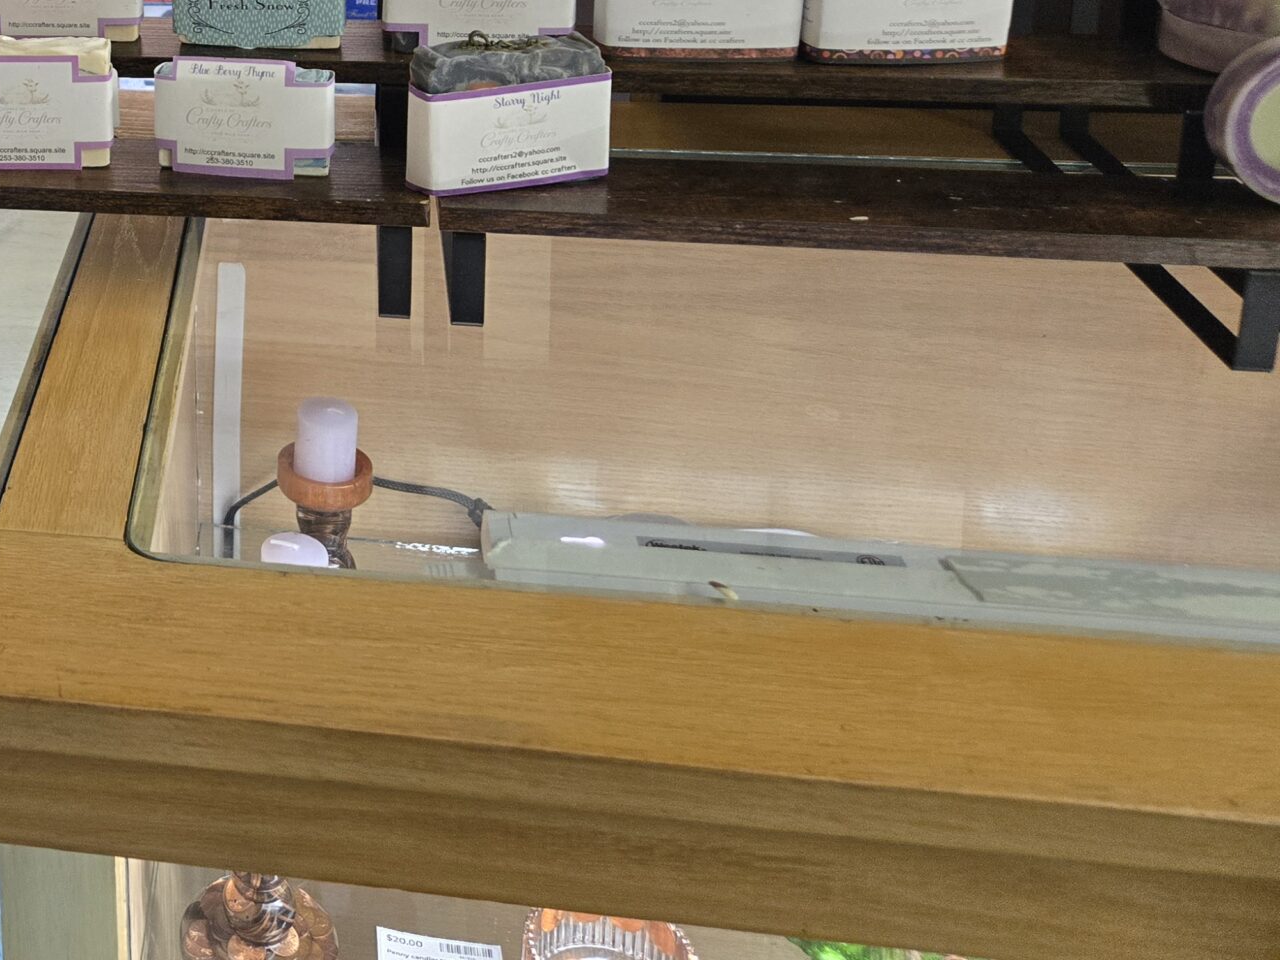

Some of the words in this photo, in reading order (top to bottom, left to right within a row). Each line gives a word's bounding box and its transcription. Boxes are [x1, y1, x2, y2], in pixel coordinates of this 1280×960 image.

[493, 95, 526, 109] Starry
[529, 89, 562, 106] Night
[17, 110, 63, 129] Crafters
[185, 106, 226, 129] Crafty
[226, 111, 272, 131] Crafters
[478, 145, 561, 164] cccrafters2@yahoo.com
[471, 155, 568, 175] http://cccrafters.square.site
[461, 176, 485, 186] Follow
[506, 170, 540, 181] Facebook
[550, 164, 577, 175] crafters
[386, 933, 423, 948] $20.00
[386, 948, 409, 959] Penny
